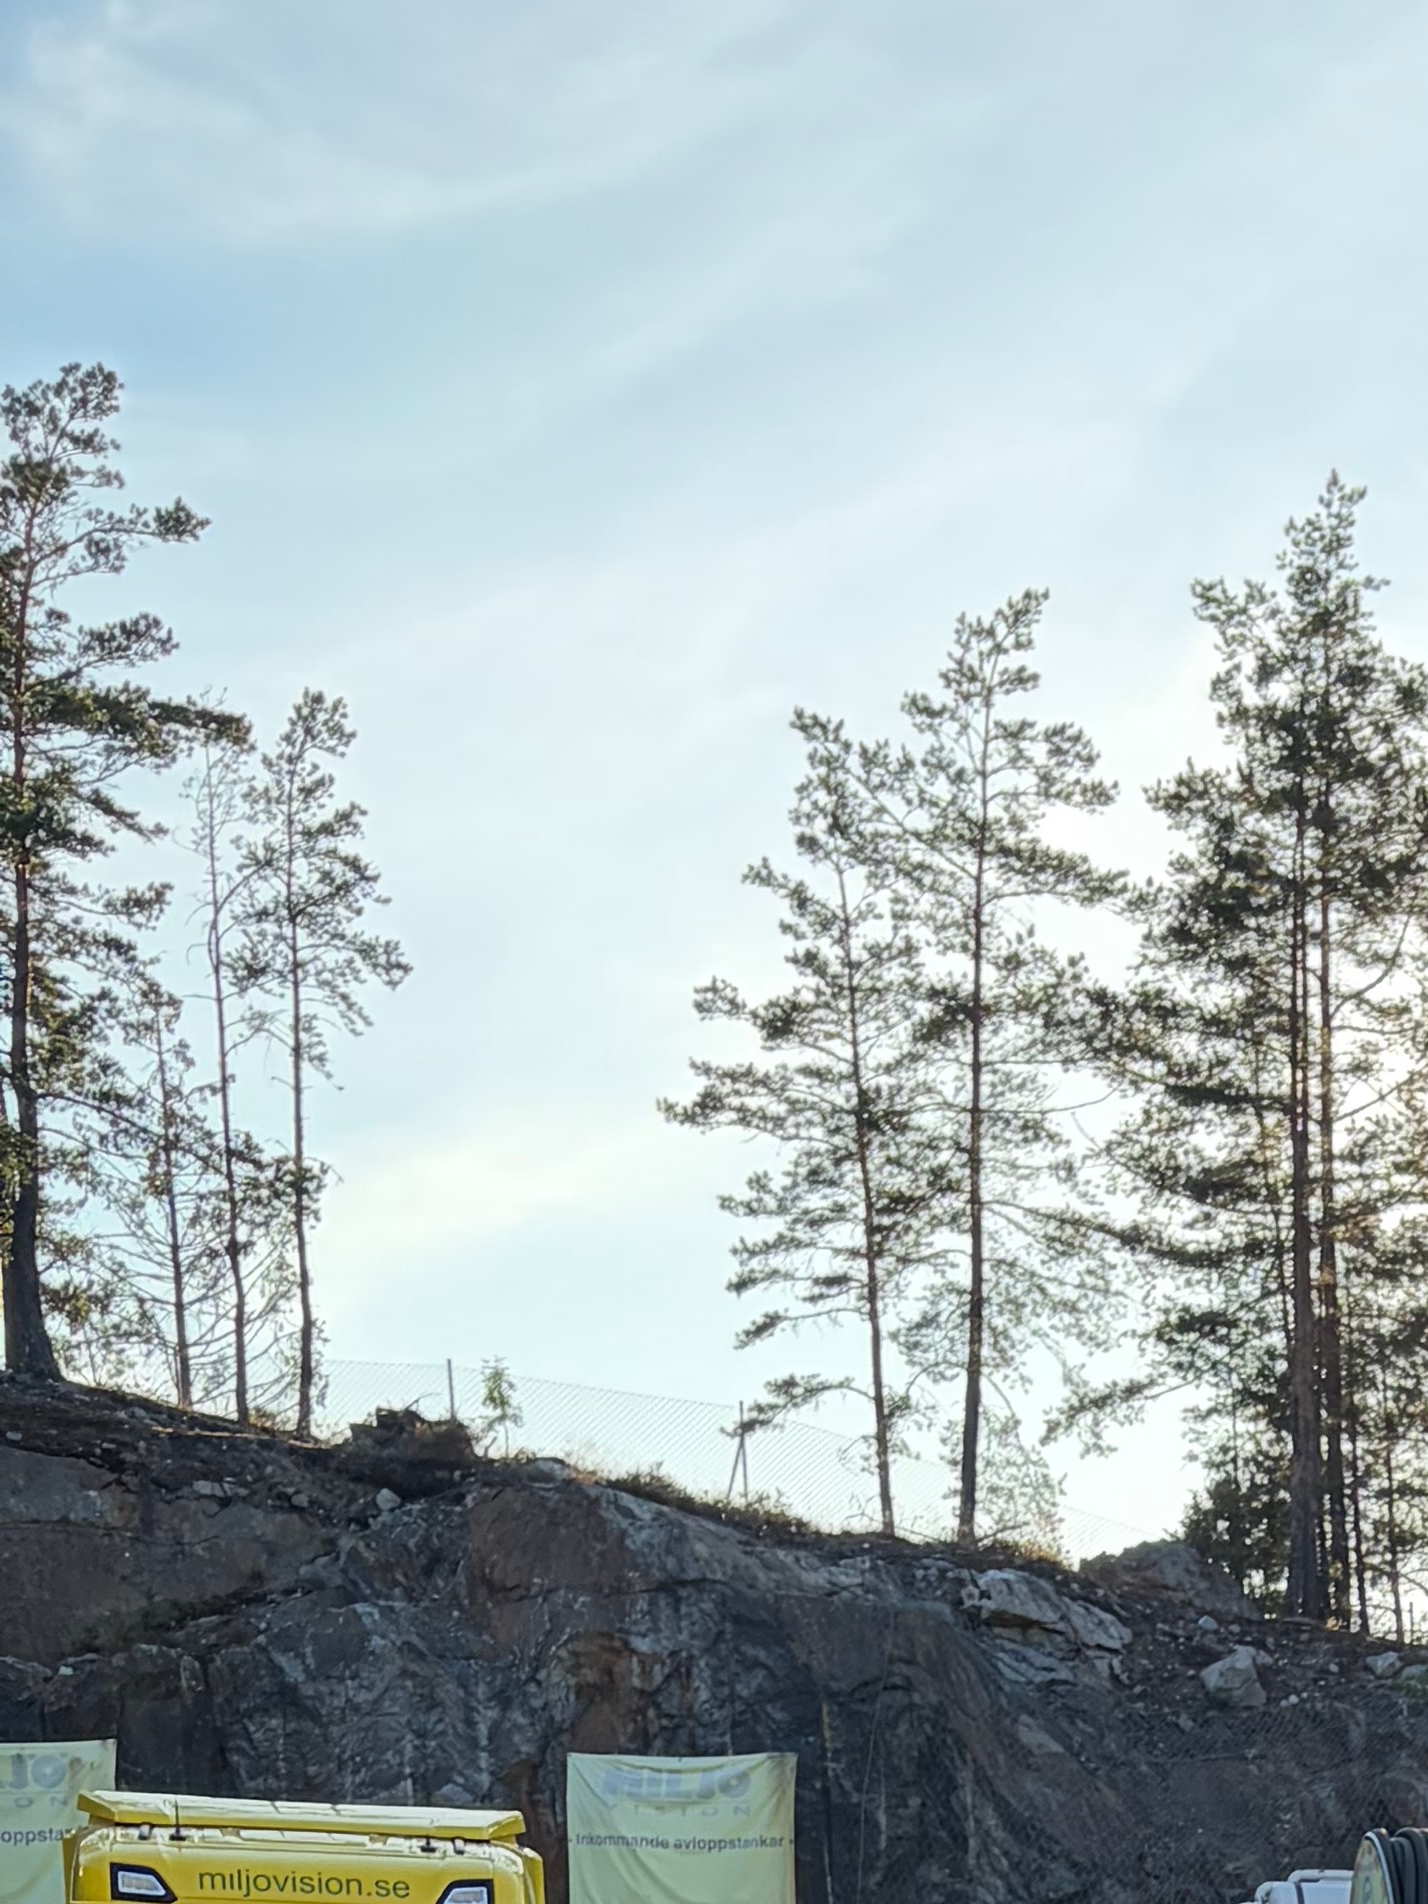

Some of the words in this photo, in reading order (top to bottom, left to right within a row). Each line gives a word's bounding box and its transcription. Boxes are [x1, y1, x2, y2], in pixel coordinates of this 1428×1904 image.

[575, 1832, 669, 1850] Inkommande
[673, 1835, 784, 1853] avloppstankar
[198, 1868, 411, 1899] miljovision.se
